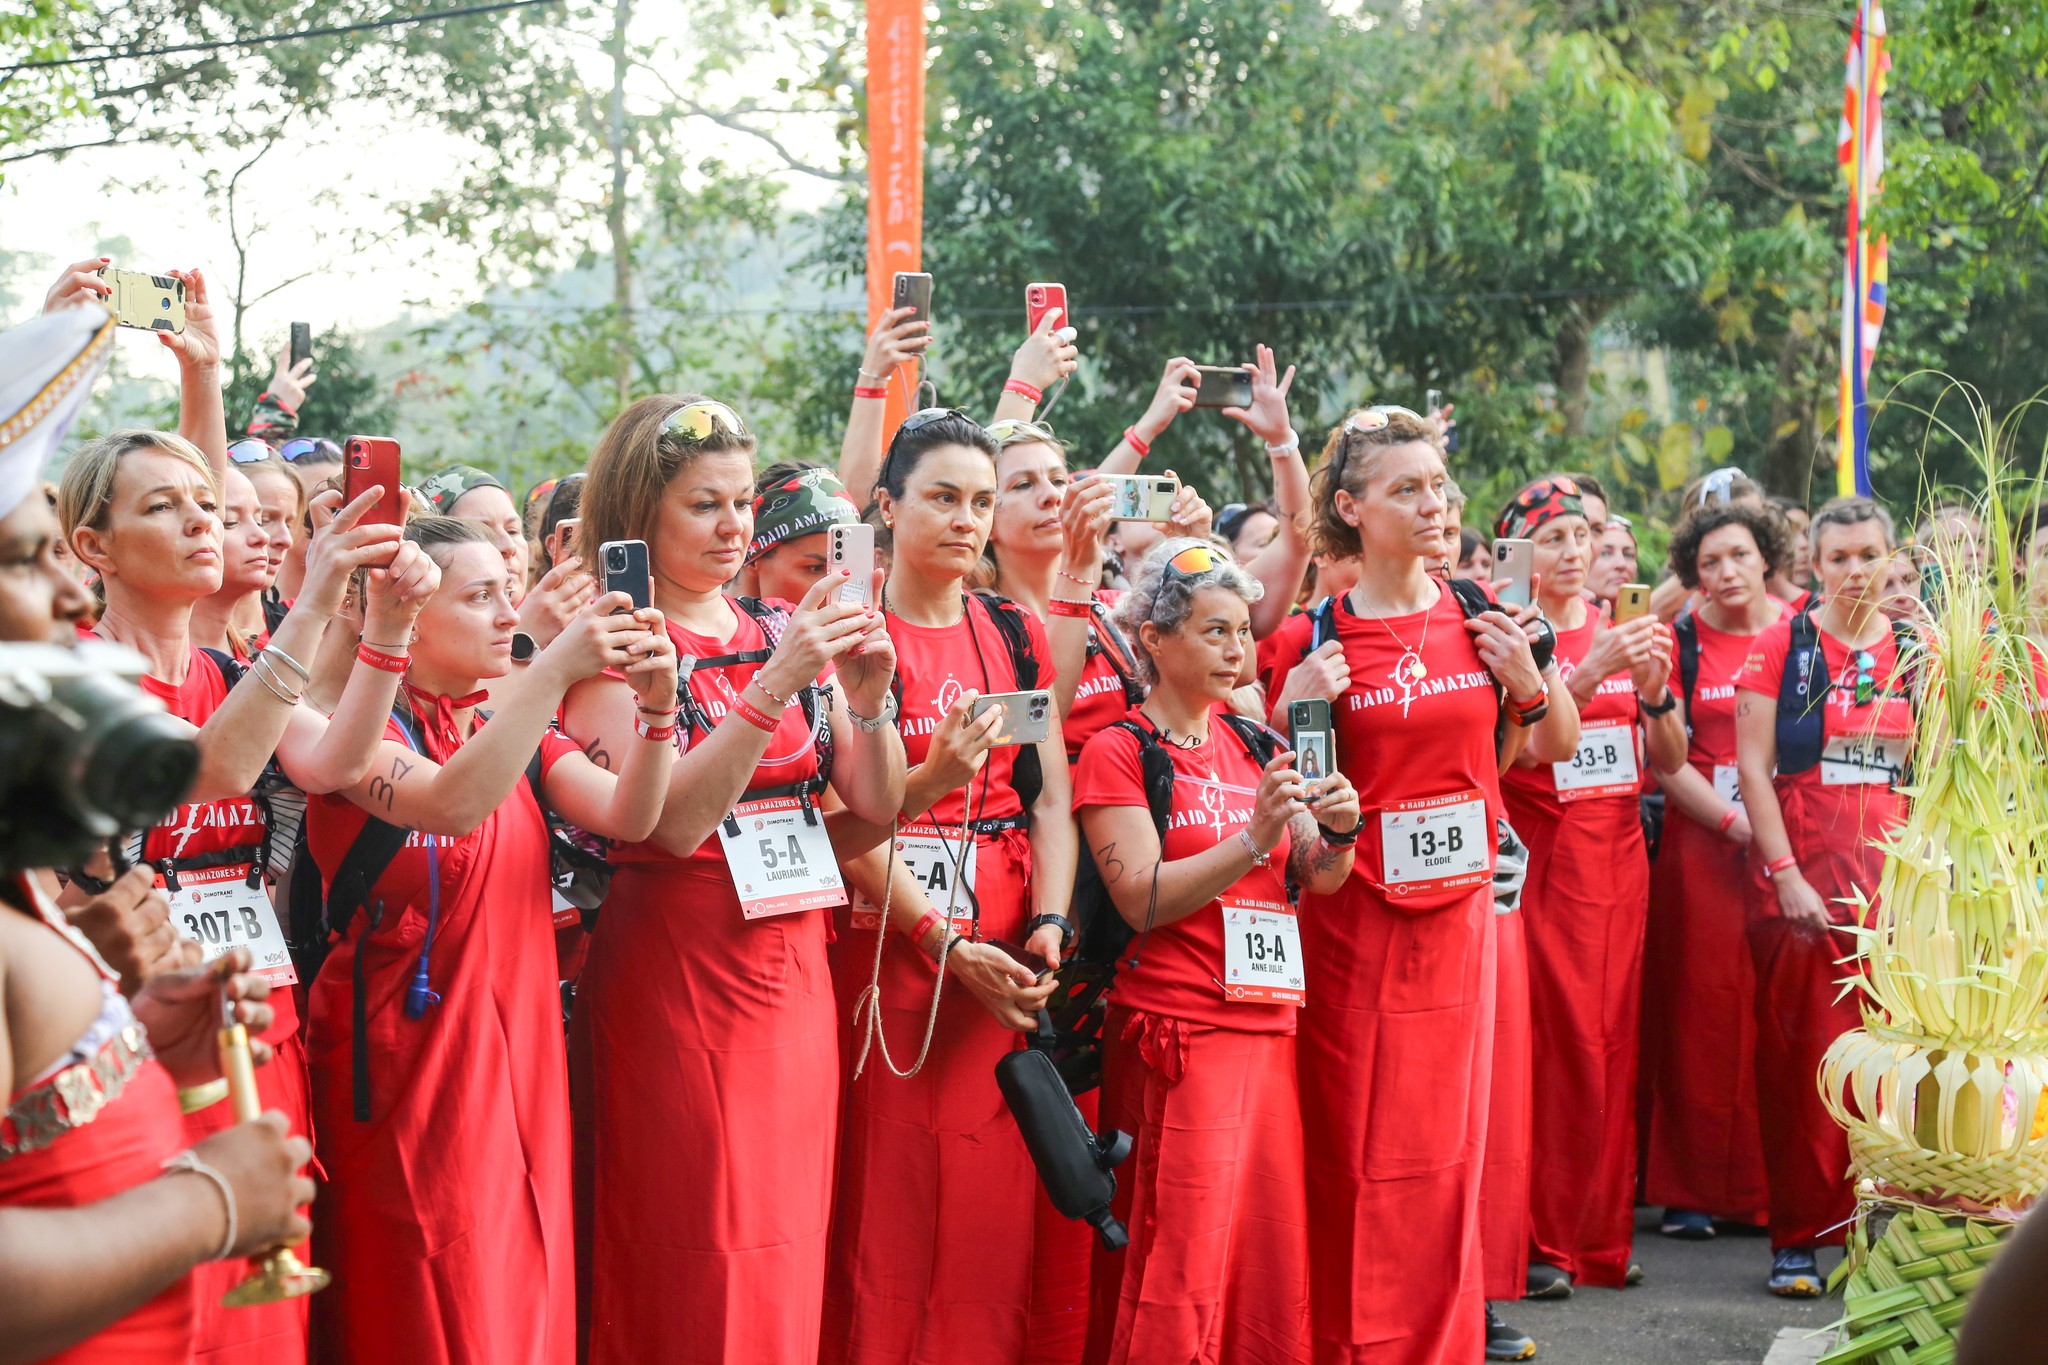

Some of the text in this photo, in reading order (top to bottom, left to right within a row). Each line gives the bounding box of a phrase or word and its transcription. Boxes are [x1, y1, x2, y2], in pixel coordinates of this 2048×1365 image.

[757, 523, 790, 549] RAID
[1350, 688, 1395, 711] RAID
[899, 717, 936, 737] AID
[740, 799, 796, 814] RAID AMAZONES
[1408, 794, 1462, 809] RAID AMAZONES
[1409, 825, 1464, 858] 13-B
[758, 834, 808, 869] 5-A
[1425, 855, 1452, 867] ELODIE
[196, 868, 236, 880] AMAZONES
[766, 866, 811, 882] LAURIANNE
[1241, 898, 1256, 906] RAID
[183, 906, 263, 945] 307-B
[1245, 932, 1286, 963] 13-A
[1252, 962, 1283, 974] ANNE JULIE
